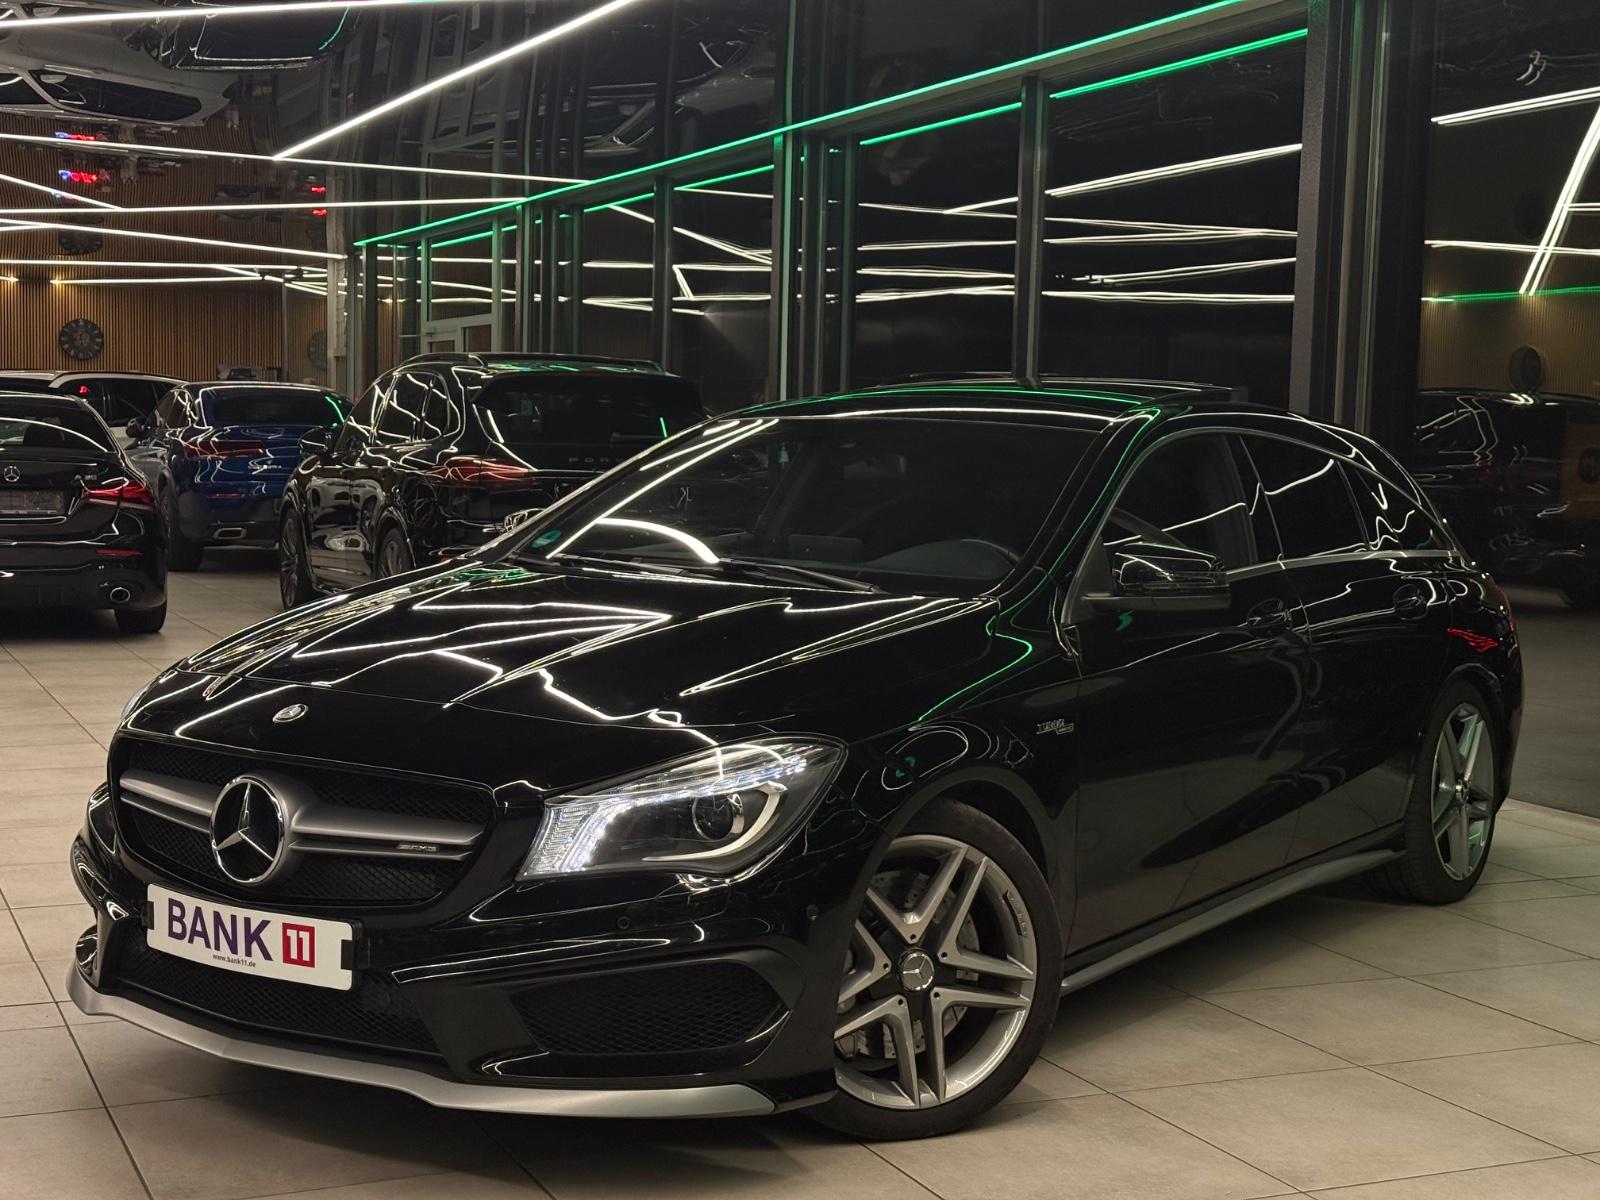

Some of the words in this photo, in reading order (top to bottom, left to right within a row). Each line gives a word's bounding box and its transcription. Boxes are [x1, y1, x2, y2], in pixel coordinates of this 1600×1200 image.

[168, 898, 273, 962] BANK
[285, 927, 313, 963] 11
[212, 954, 257, 968] www.bank11.de
